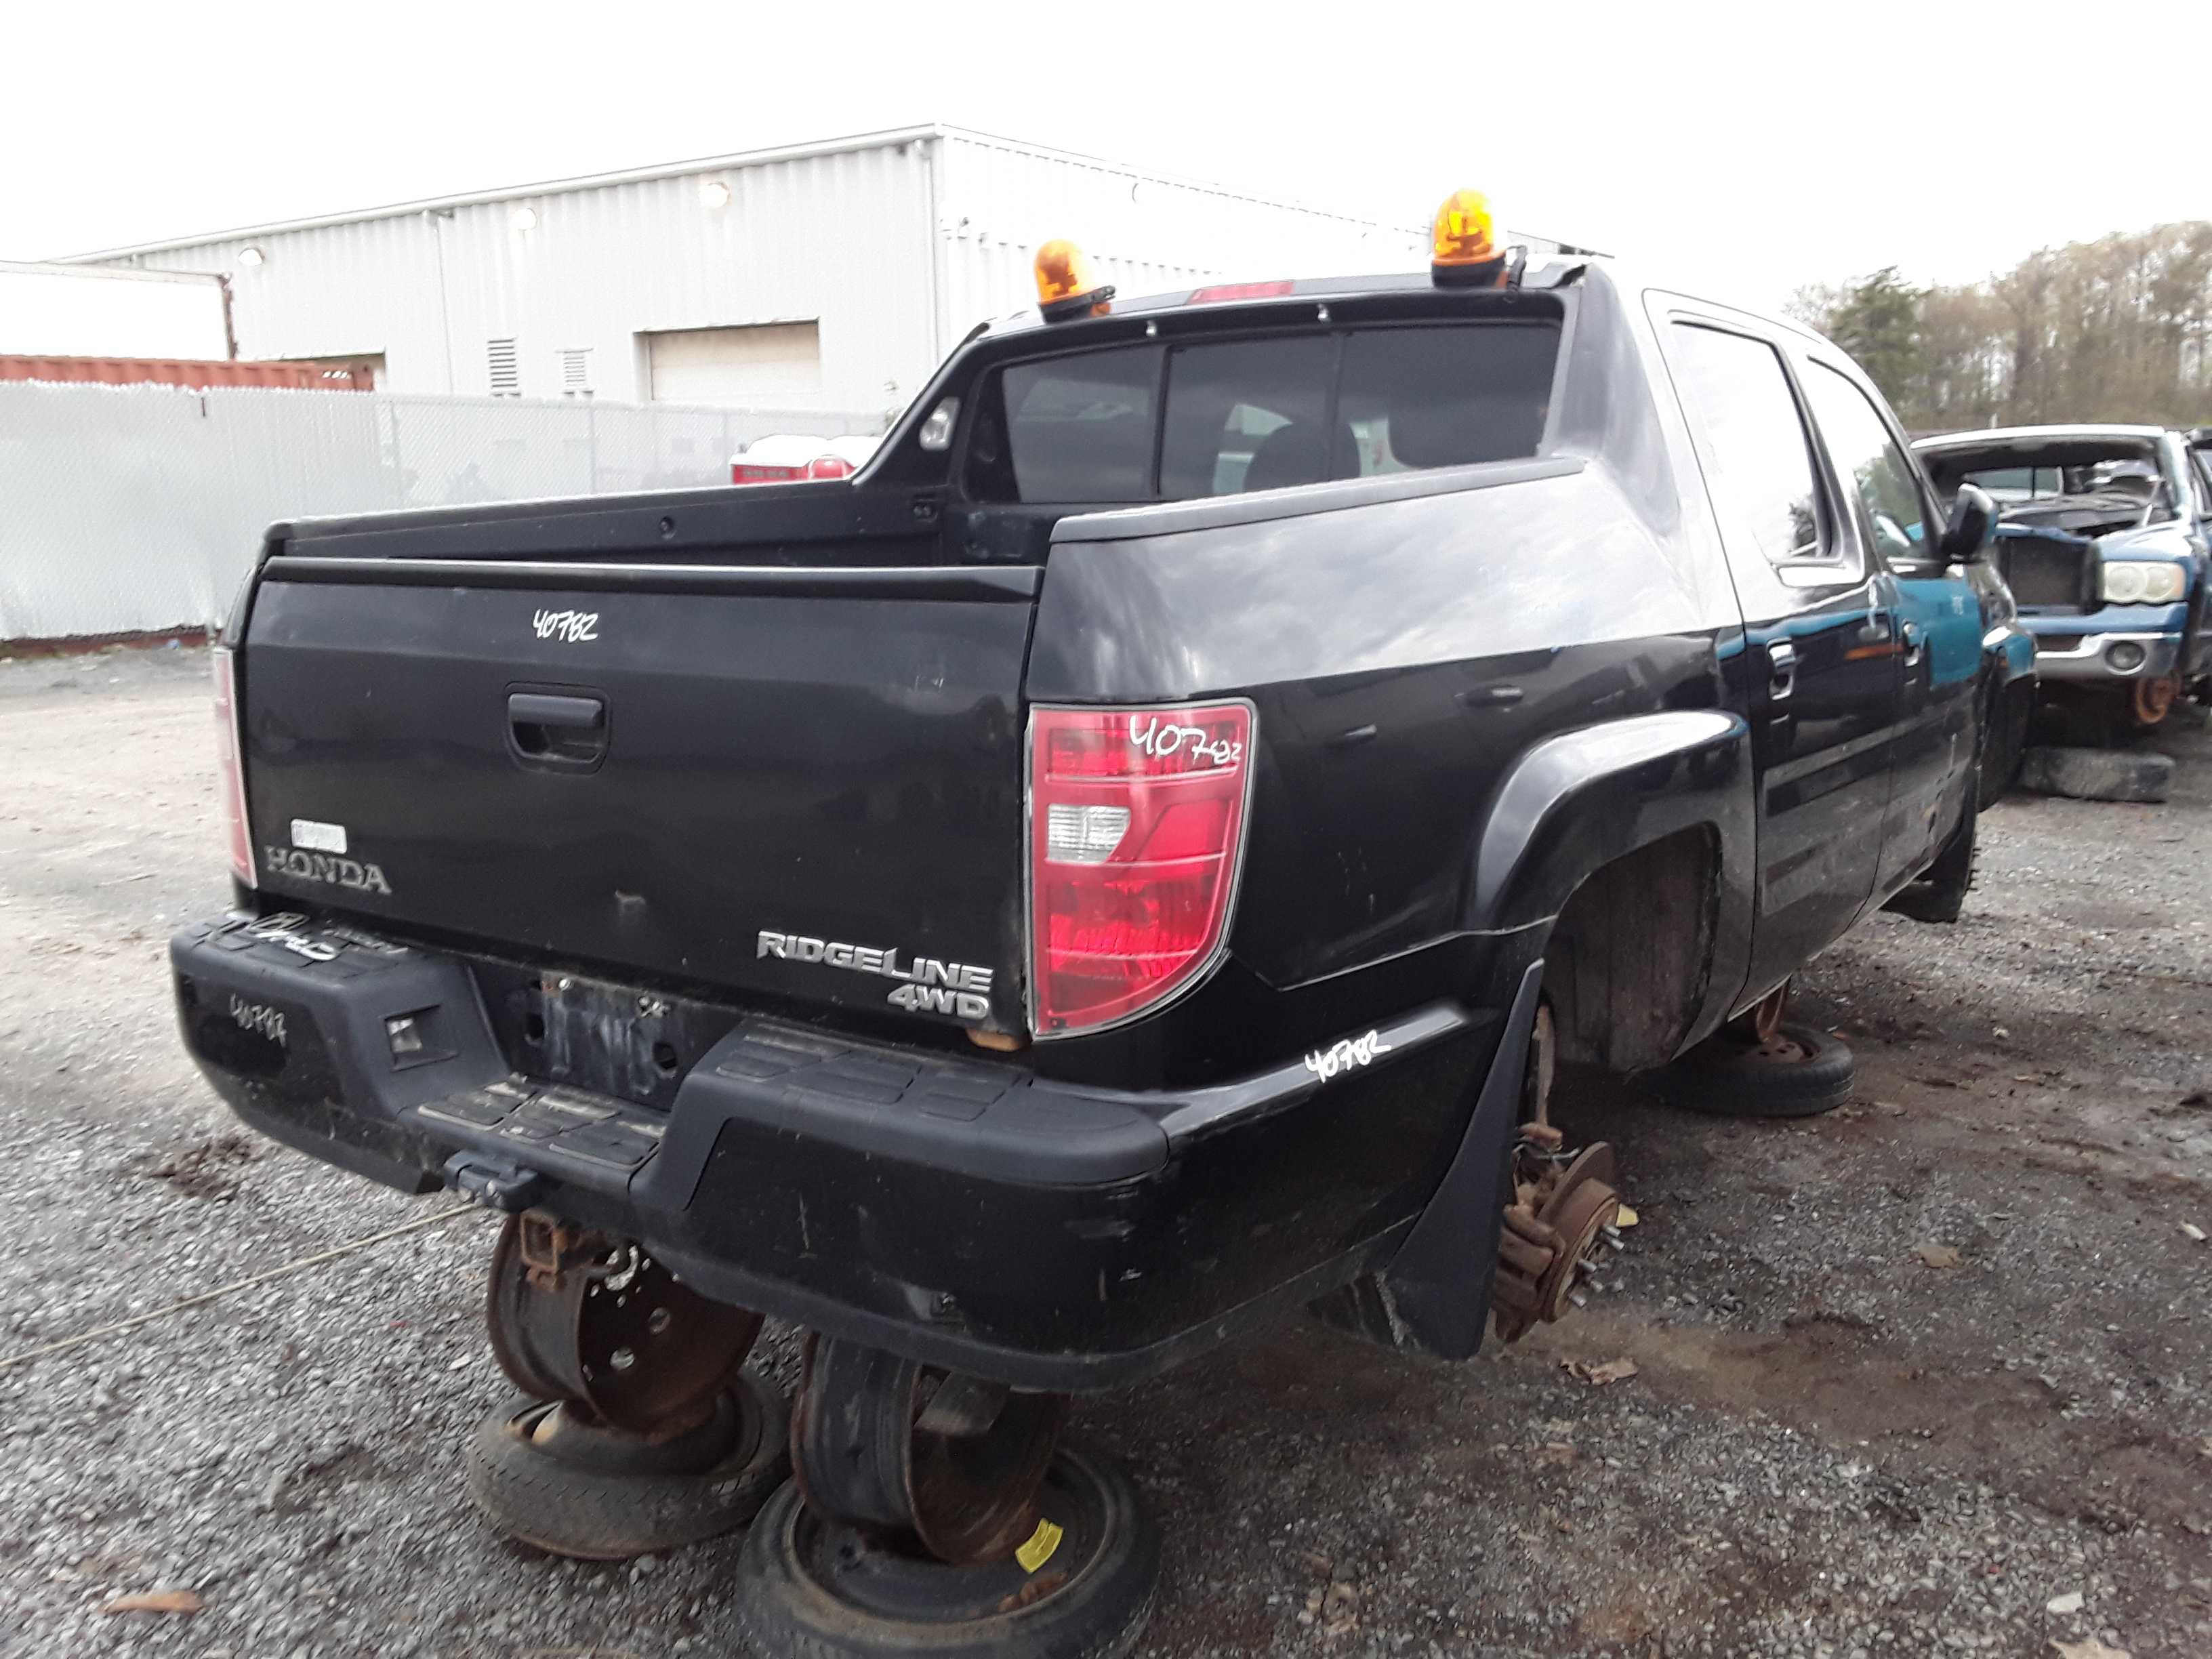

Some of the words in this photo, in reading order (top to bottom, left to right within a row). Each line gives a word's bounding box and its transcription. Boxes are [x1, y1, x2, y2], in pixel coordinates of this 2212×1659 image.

[533, 609, 598, 642] 40782
[1130, 716, 1242, 764] 40782
[265, 845, 392, 895] HONDA
[756, 930, 994, 994] RIDGELINE
[888, 983, 989, 1019] 4WD
[1305, 1029, 1391, 1084] 40782
